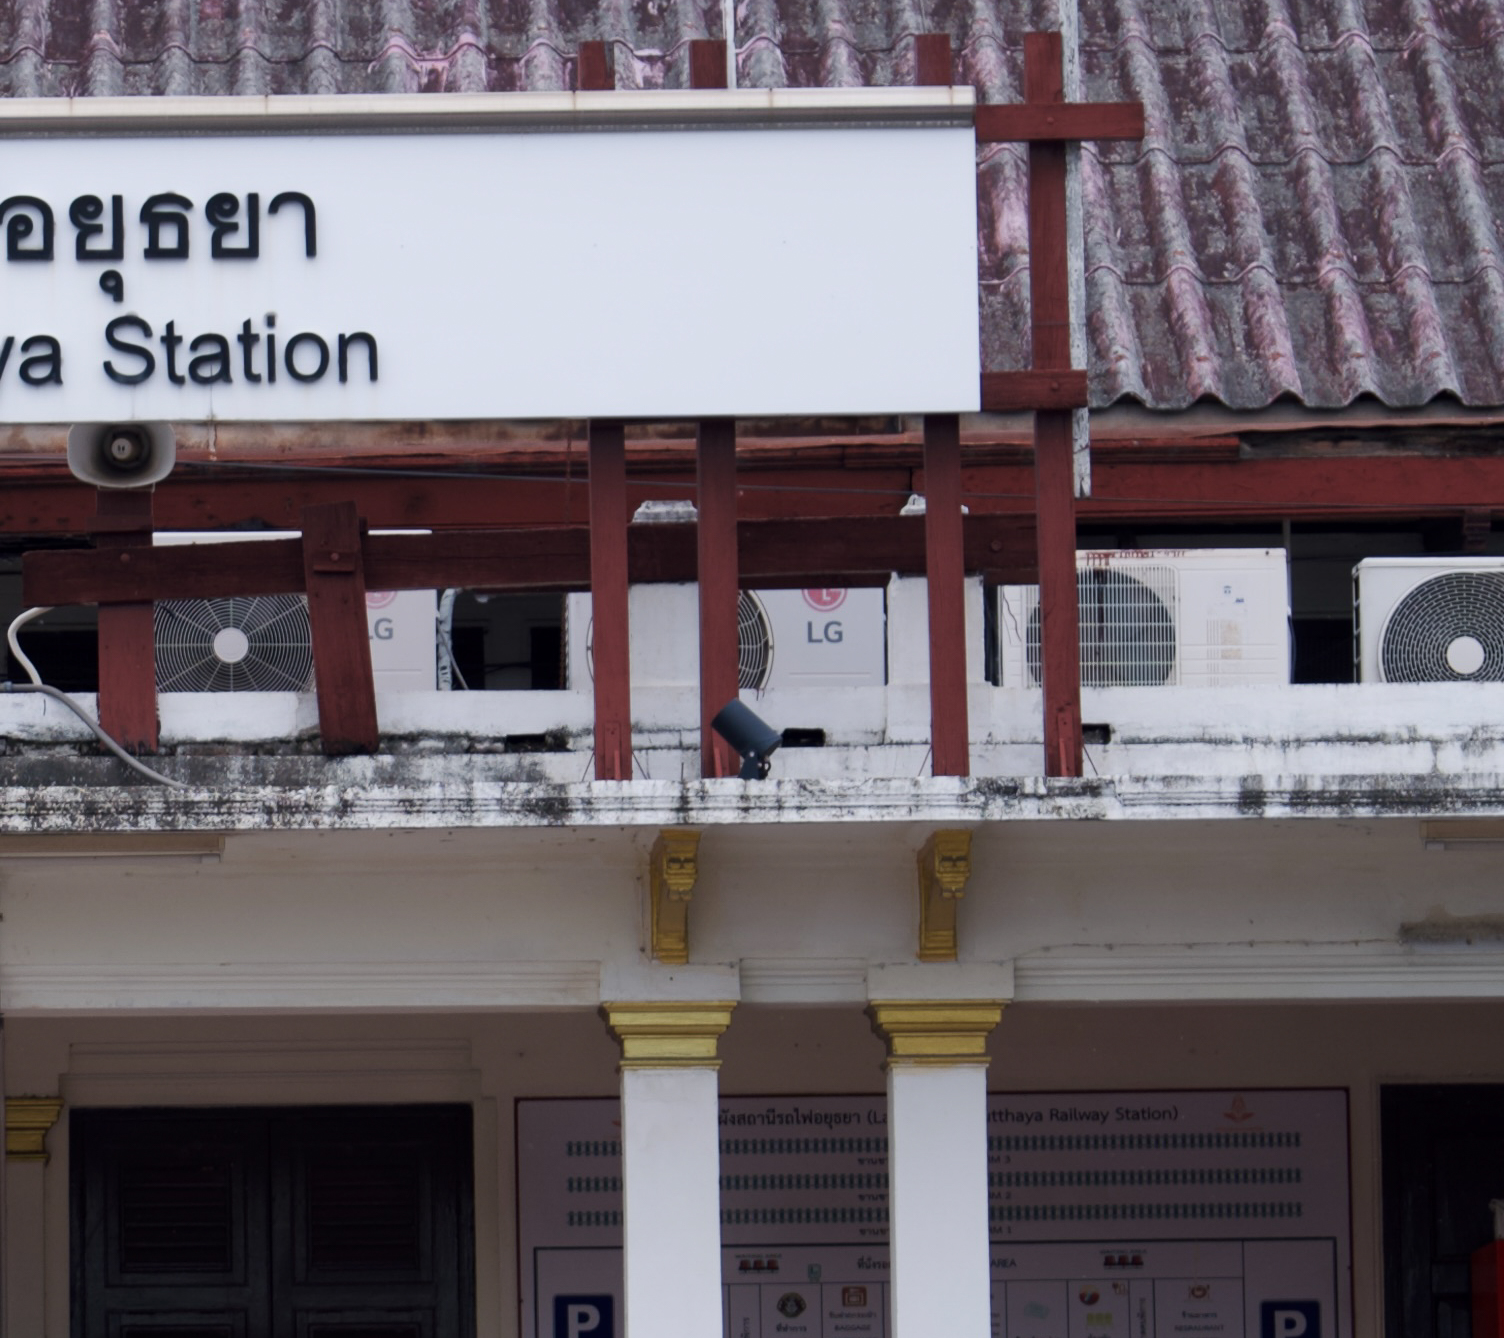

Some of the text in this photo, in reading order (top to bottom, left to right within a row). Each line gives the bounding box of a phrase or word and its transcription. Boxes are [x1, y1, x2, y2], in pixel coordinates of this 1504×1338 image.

[103, 313, 382, 388] Station
[807, 620, 844, 643] LG
[1049, 1107, 1111, 1127] Railway
[1116, 1104, 1179, 1122] Station)
